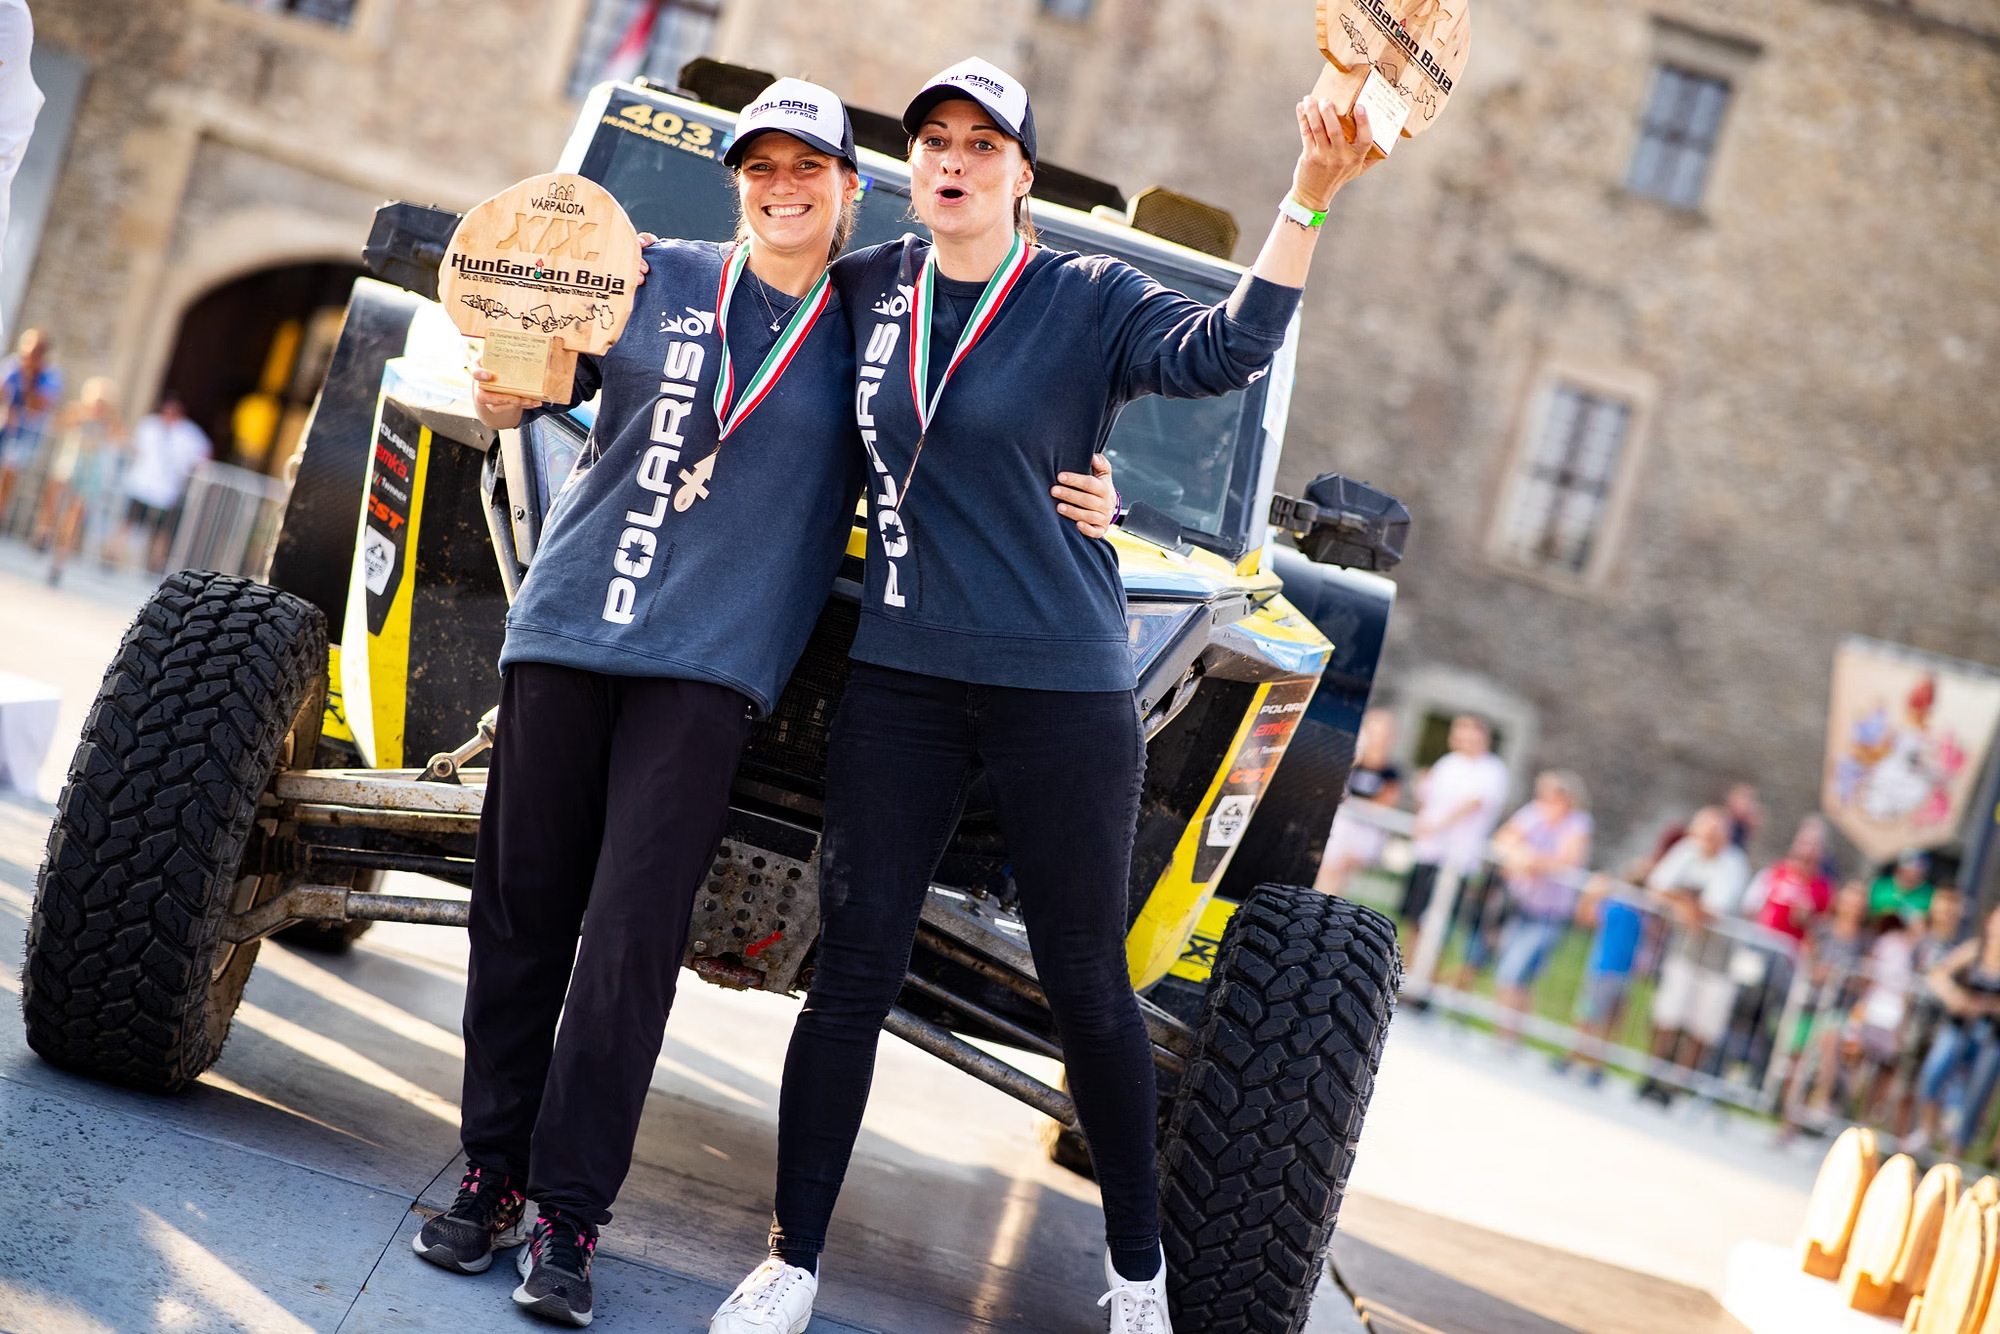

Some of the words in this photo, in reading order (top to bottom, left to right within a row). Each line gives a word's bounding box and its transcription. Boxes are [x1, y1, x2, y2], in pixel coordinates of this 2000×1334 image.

[1420, 49, 1453, 91] Baja
[620, 104, 714, 146] 403
[750, 100, 818, 117] POLARIS
[799, 112, 817, 121] ROAD
[601, 115, 681, 147] HUNGARIAN
[679, 141, 716, 159] BAJA
[531, 197, 585, 216] VÁRPALOTA
[575, 269, 625, 291] Baja
[380, 422, 417, 461] OLARIS
[602, 340, 706, 624] POLARIS
